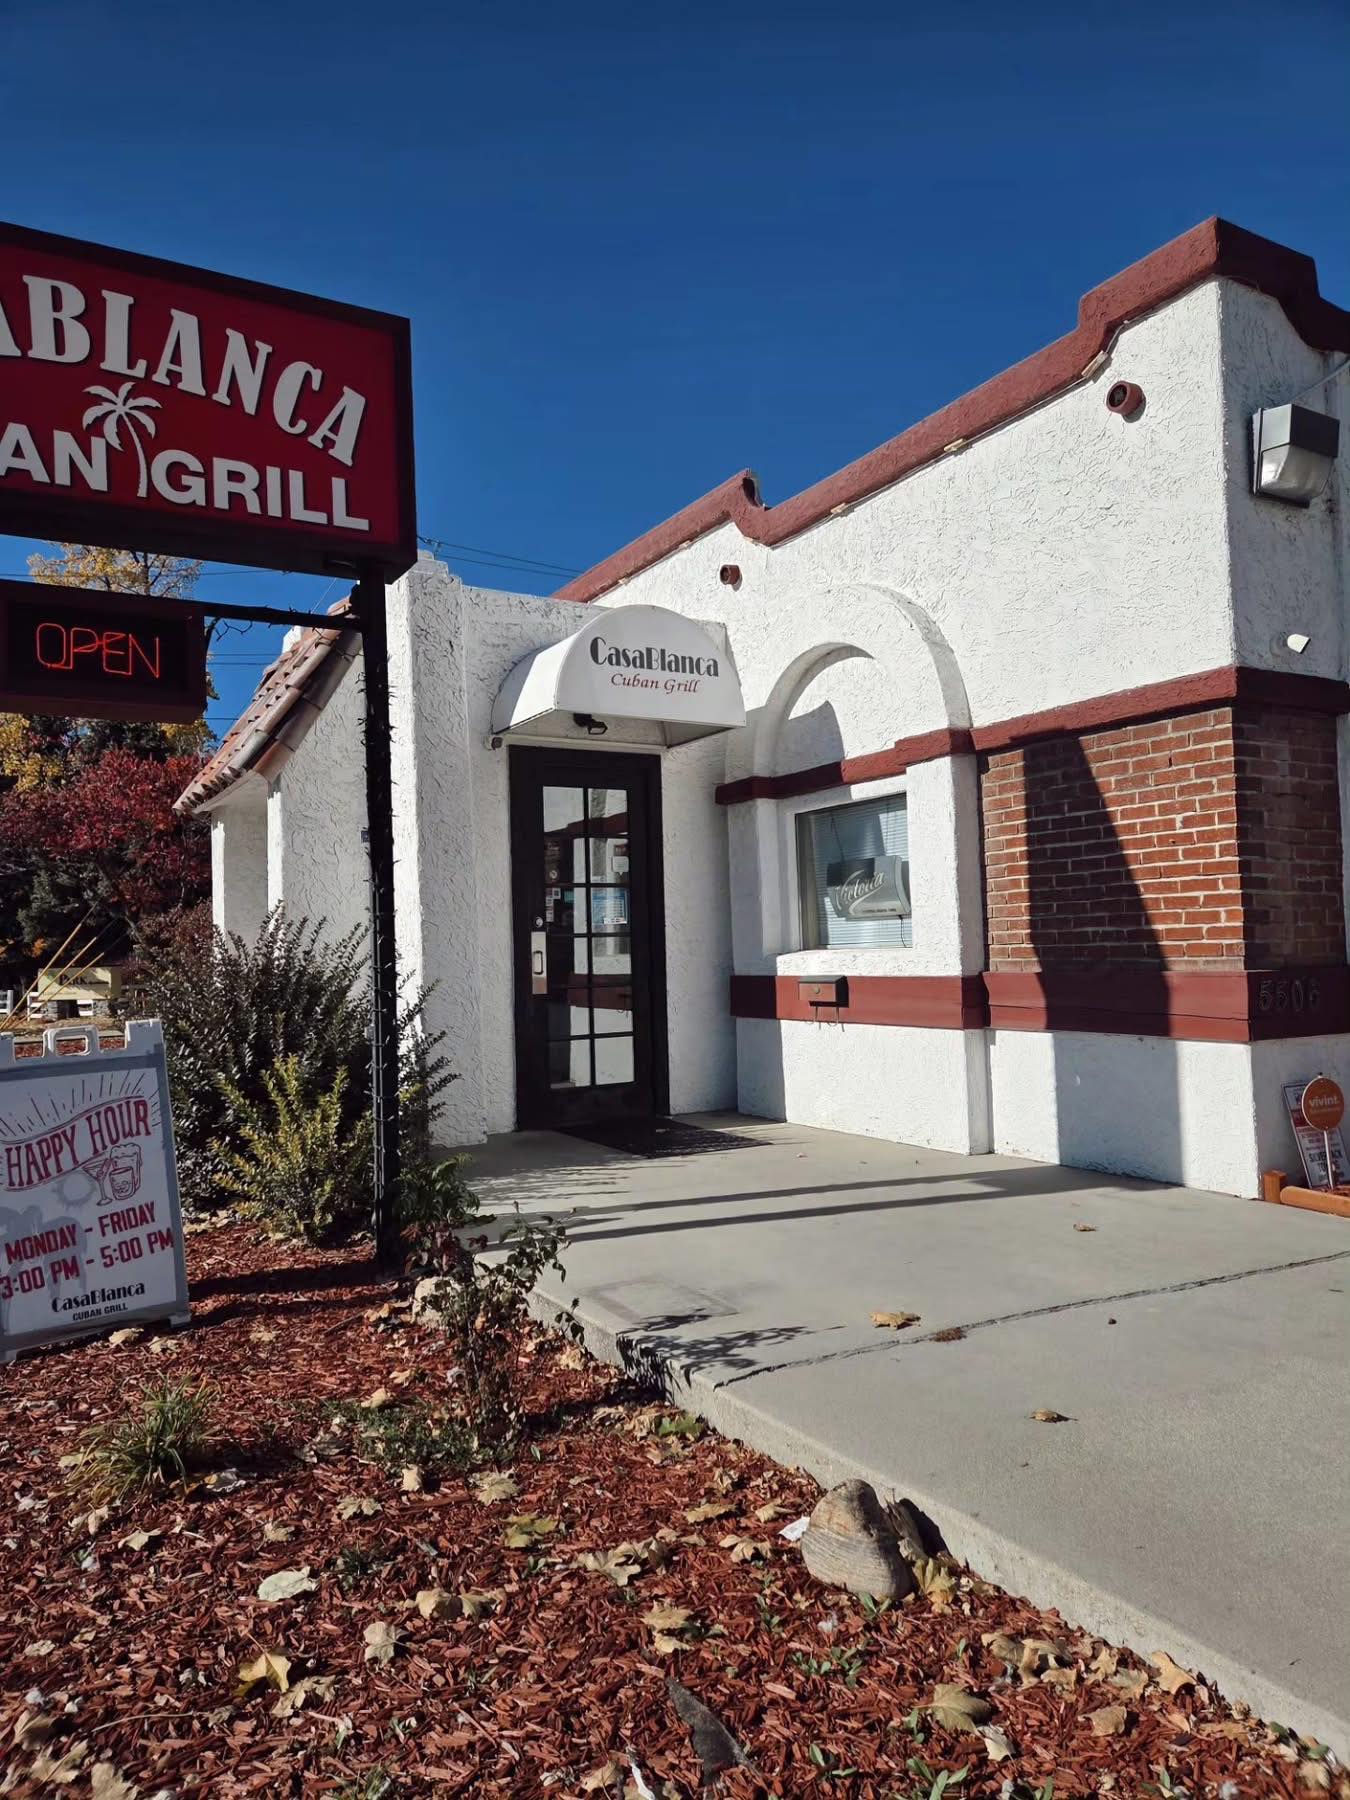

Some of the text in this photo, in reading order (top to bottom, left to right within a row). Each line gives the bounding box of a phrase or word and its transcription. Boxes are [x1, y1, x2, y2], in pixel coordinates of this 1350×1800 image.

[150, 450, 369, 531] GRILL
[36, 623, 159, 678] OPEN
[590, 637, 719, 677] CasaBlanca
[611, 673, 701, 694] Cuban Grill
[4, 1099, 152, 1187] HAPPY HOUR
[5, 1224, 77, 1265] MONDAY
[98, 1202, 156, 1237] FRIDAY
[0, 1266, 46, 1300] 3:00
[50, 1256, 81, 1284] PM
[100, 1236, 143, 1268] 5:00
[147, 1228, 174, 1254] PM
[51, 1282, 146, 1313] CasaBlanca
[72, 1303, 129, 1321] CUBAN GRILL
